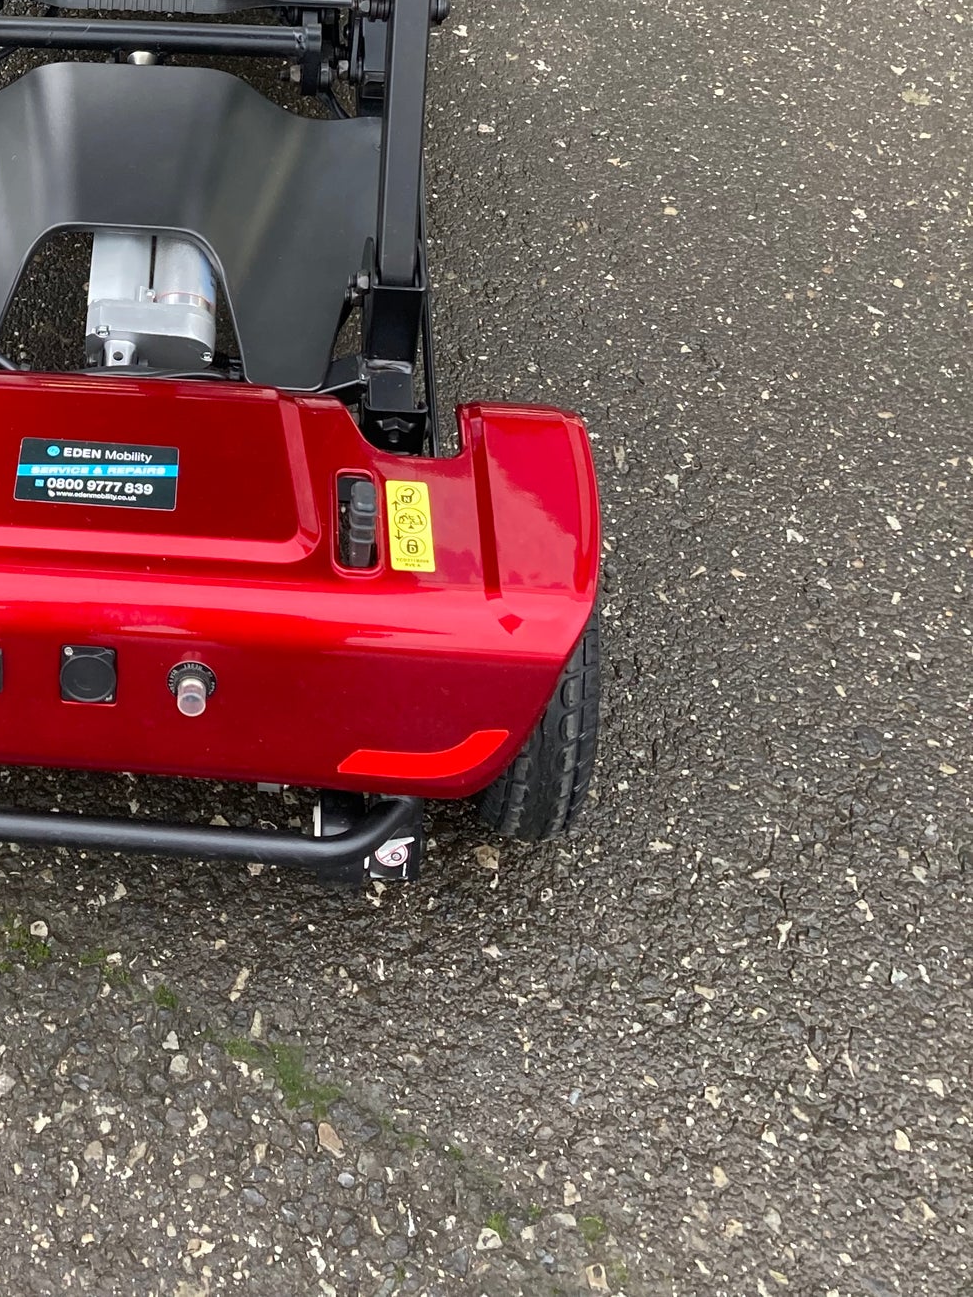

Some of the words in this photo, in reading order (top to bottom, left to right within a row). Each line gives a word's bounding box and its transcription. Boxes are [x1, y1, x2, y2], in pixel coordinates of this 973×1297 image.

[63, 447, 101, 459] EDEN
[105, 450, 152, 464] Mobility
[31, 466, 89, 475] SERVICE
[93, 467, 103, 475] &
[107, 467, 166, 475] REPAIRS
[47, 478, 84, 490] 0800
[87, 481, 123, 493] 9777
[124, 483, 153, 495] 839
[56, 490, 136, 502] www.edenmobility.co.uk
